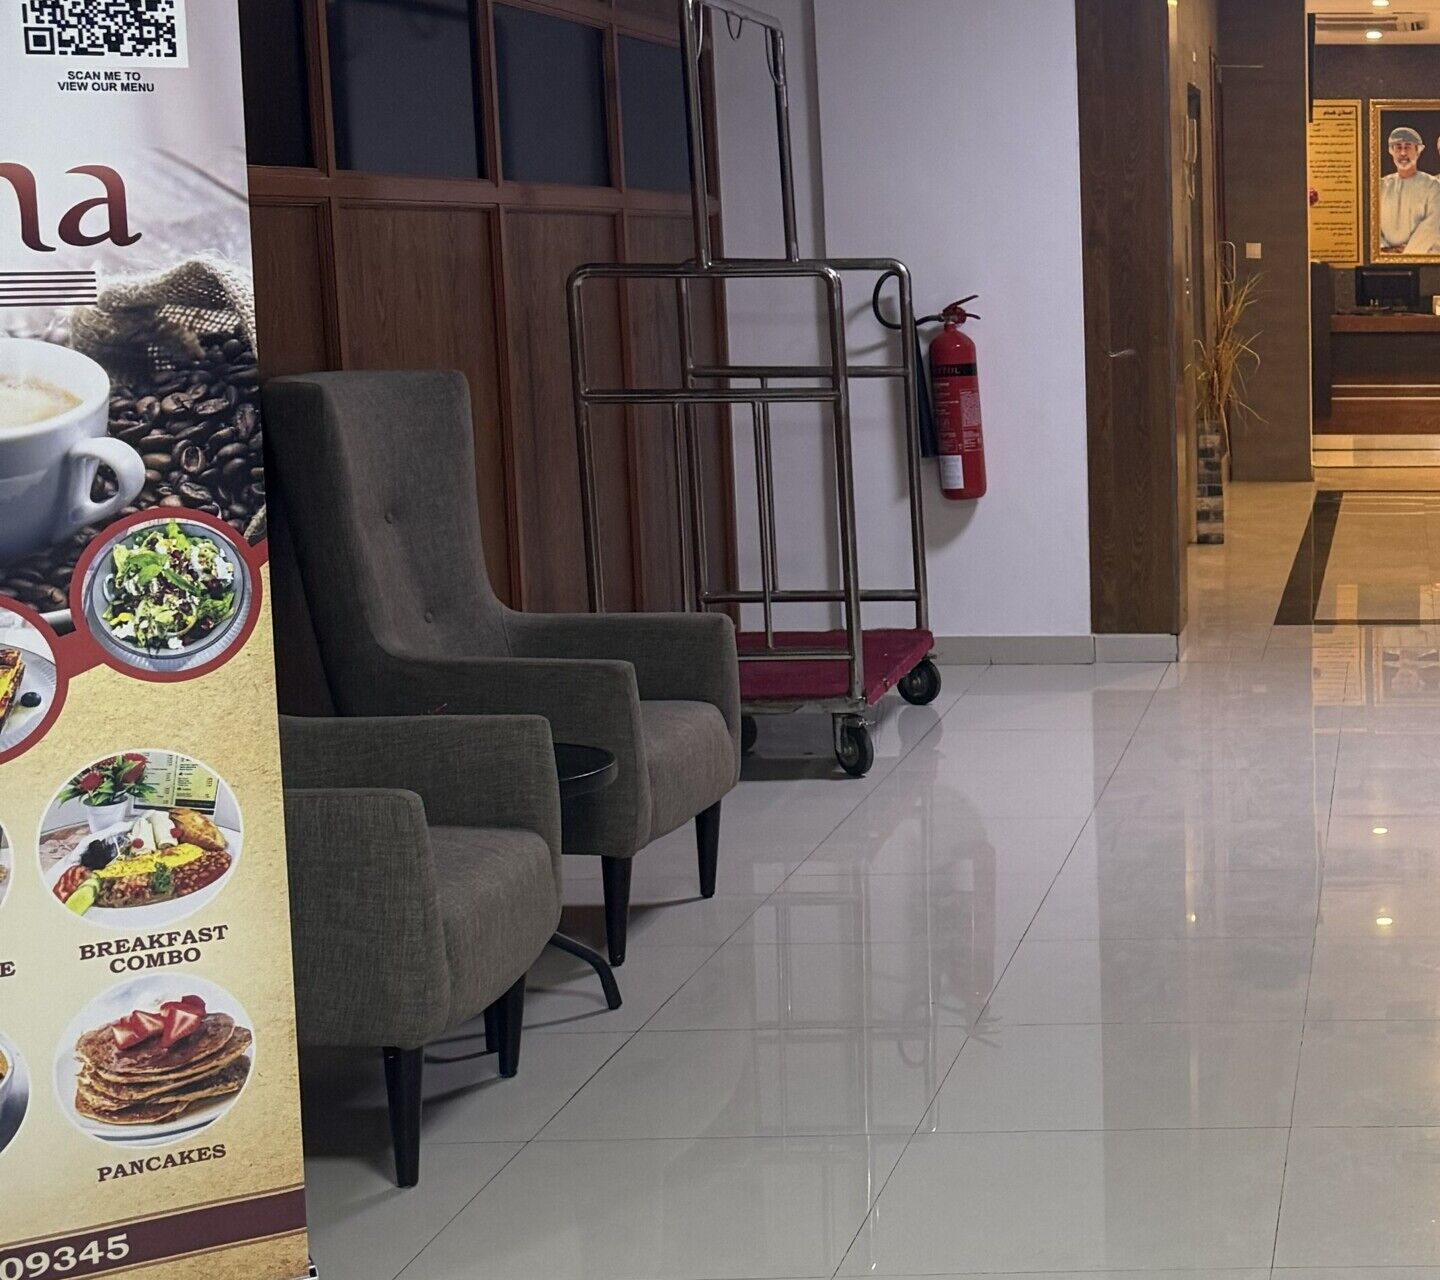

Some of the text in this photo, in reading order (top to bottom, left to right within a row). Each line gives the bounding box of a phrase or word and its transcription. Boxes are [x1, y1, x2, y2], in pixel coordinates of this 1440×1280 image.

[57, 81, 155, 92] VIEW OUR MENU
[67, 70, 141, 81] SCAN ME TO
[78, 924, 229, 961] BREAKFAST
[109, 947, 202, 974] COMBO
[97, 1143, 227, 1182] PANCAKES
